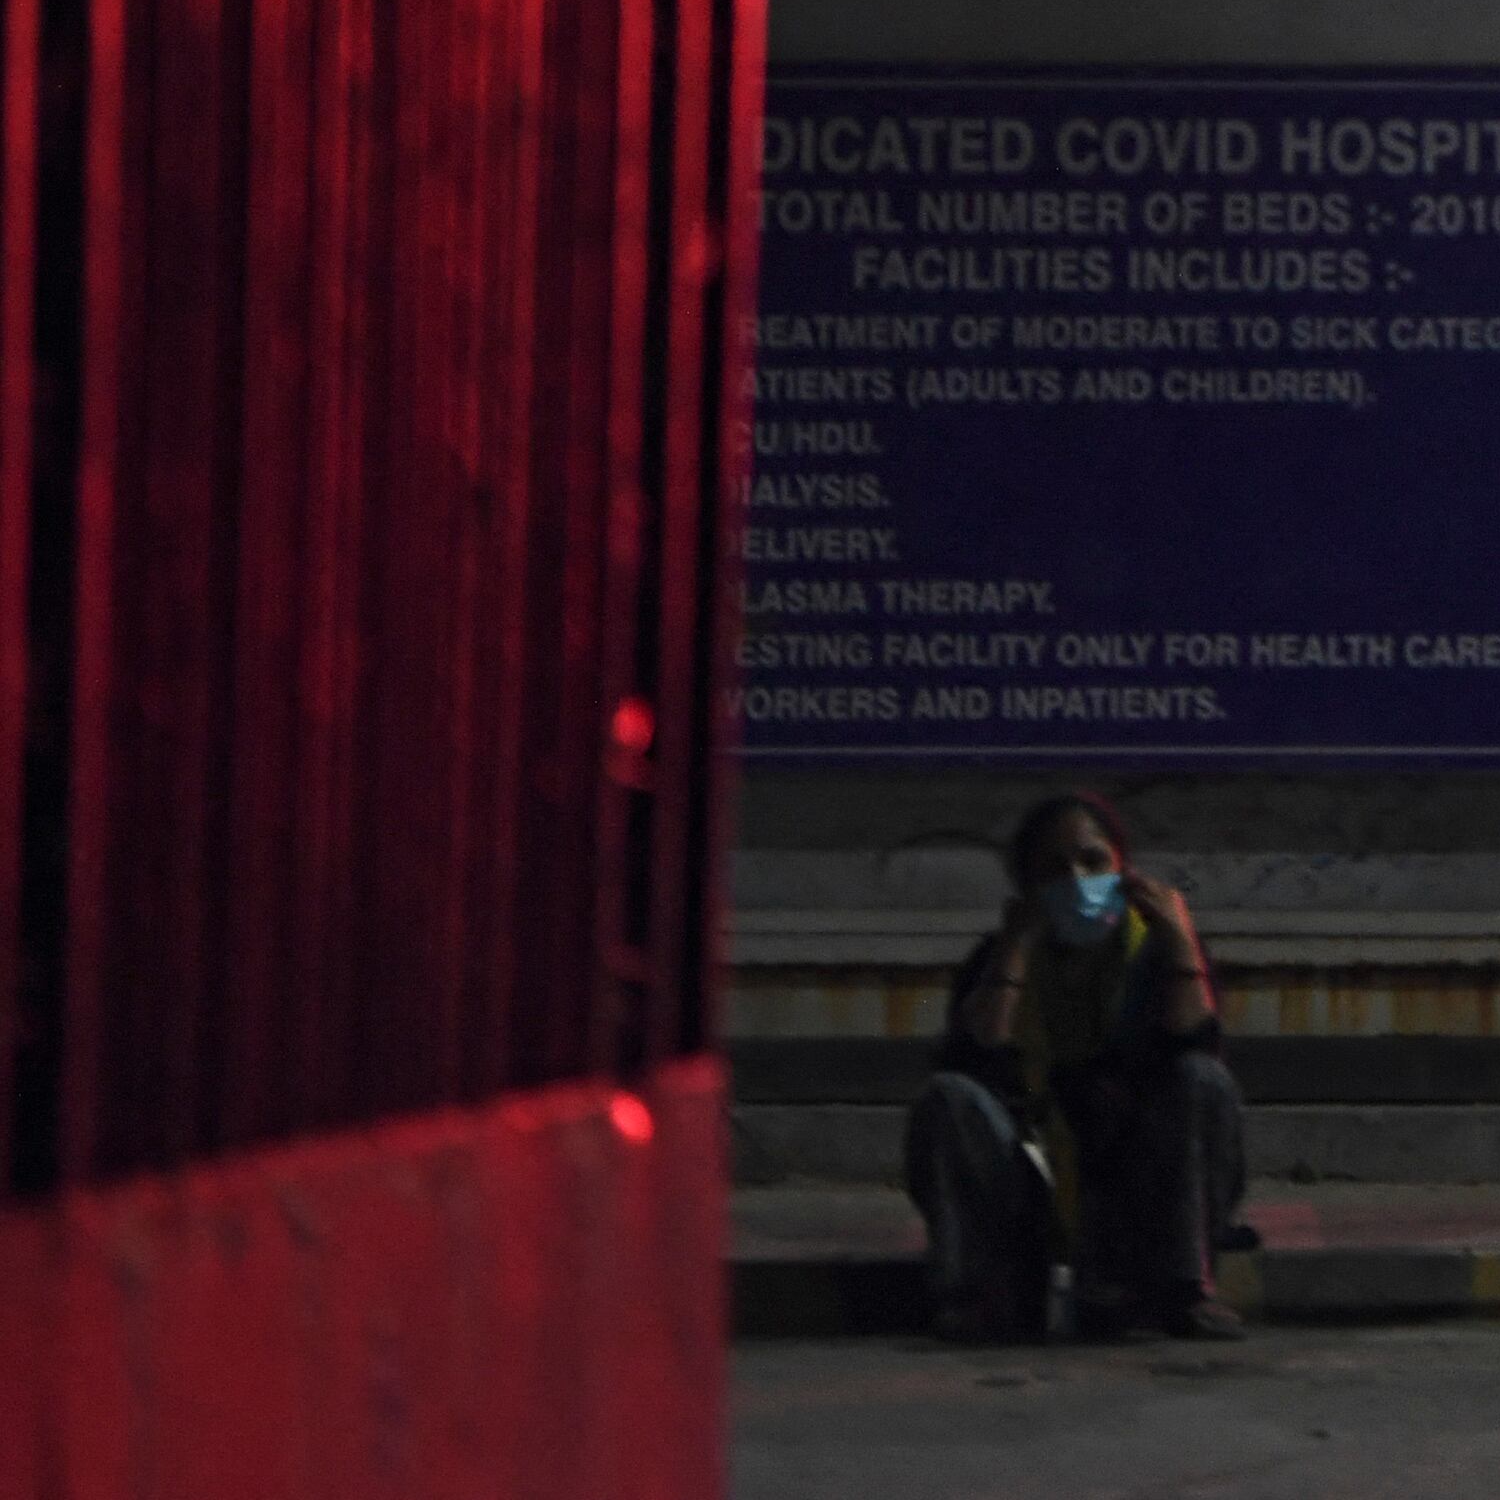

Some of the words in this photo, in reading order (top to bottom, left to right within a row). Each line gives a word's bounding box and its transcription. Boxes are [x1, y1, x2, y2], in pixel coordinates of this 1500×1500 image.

[763, 116, 1034, 175] DICATED
[1056, 116, 1259, 176] COVID
[917, 190, 1128, 234] NUMBER
[1143, 192, 1207, 235] OF
[1222, 192, 1352, 236] BEDS
[852, 247, 1112, 290] FACILITIES
[1128, 248, 1370, 292] INCLUDES
[951, 315, 1002, 348] OF
[1013, 315, 1218, 350] MODERATE
[1229, 316, 1280, 350] TO
[1290, 316, 1378, 350] SICK
[738, 367, 895, 402] ATIENTS
[1072, 368, 1152, 401] AND
[735, 527, 899, 561] ELIVERY.
[733, 579, 867, 613] LASMA
[733, 632, 871, 668] ESTING
[883, 632, 1046, 668] FACILITY
[1055, 633, 1155, 668] ONLY
[1162, 634, 1240, 667] FOR
[1250, 633, 1394, 668] HEALTH
[912, 687, 990, 720] AND
